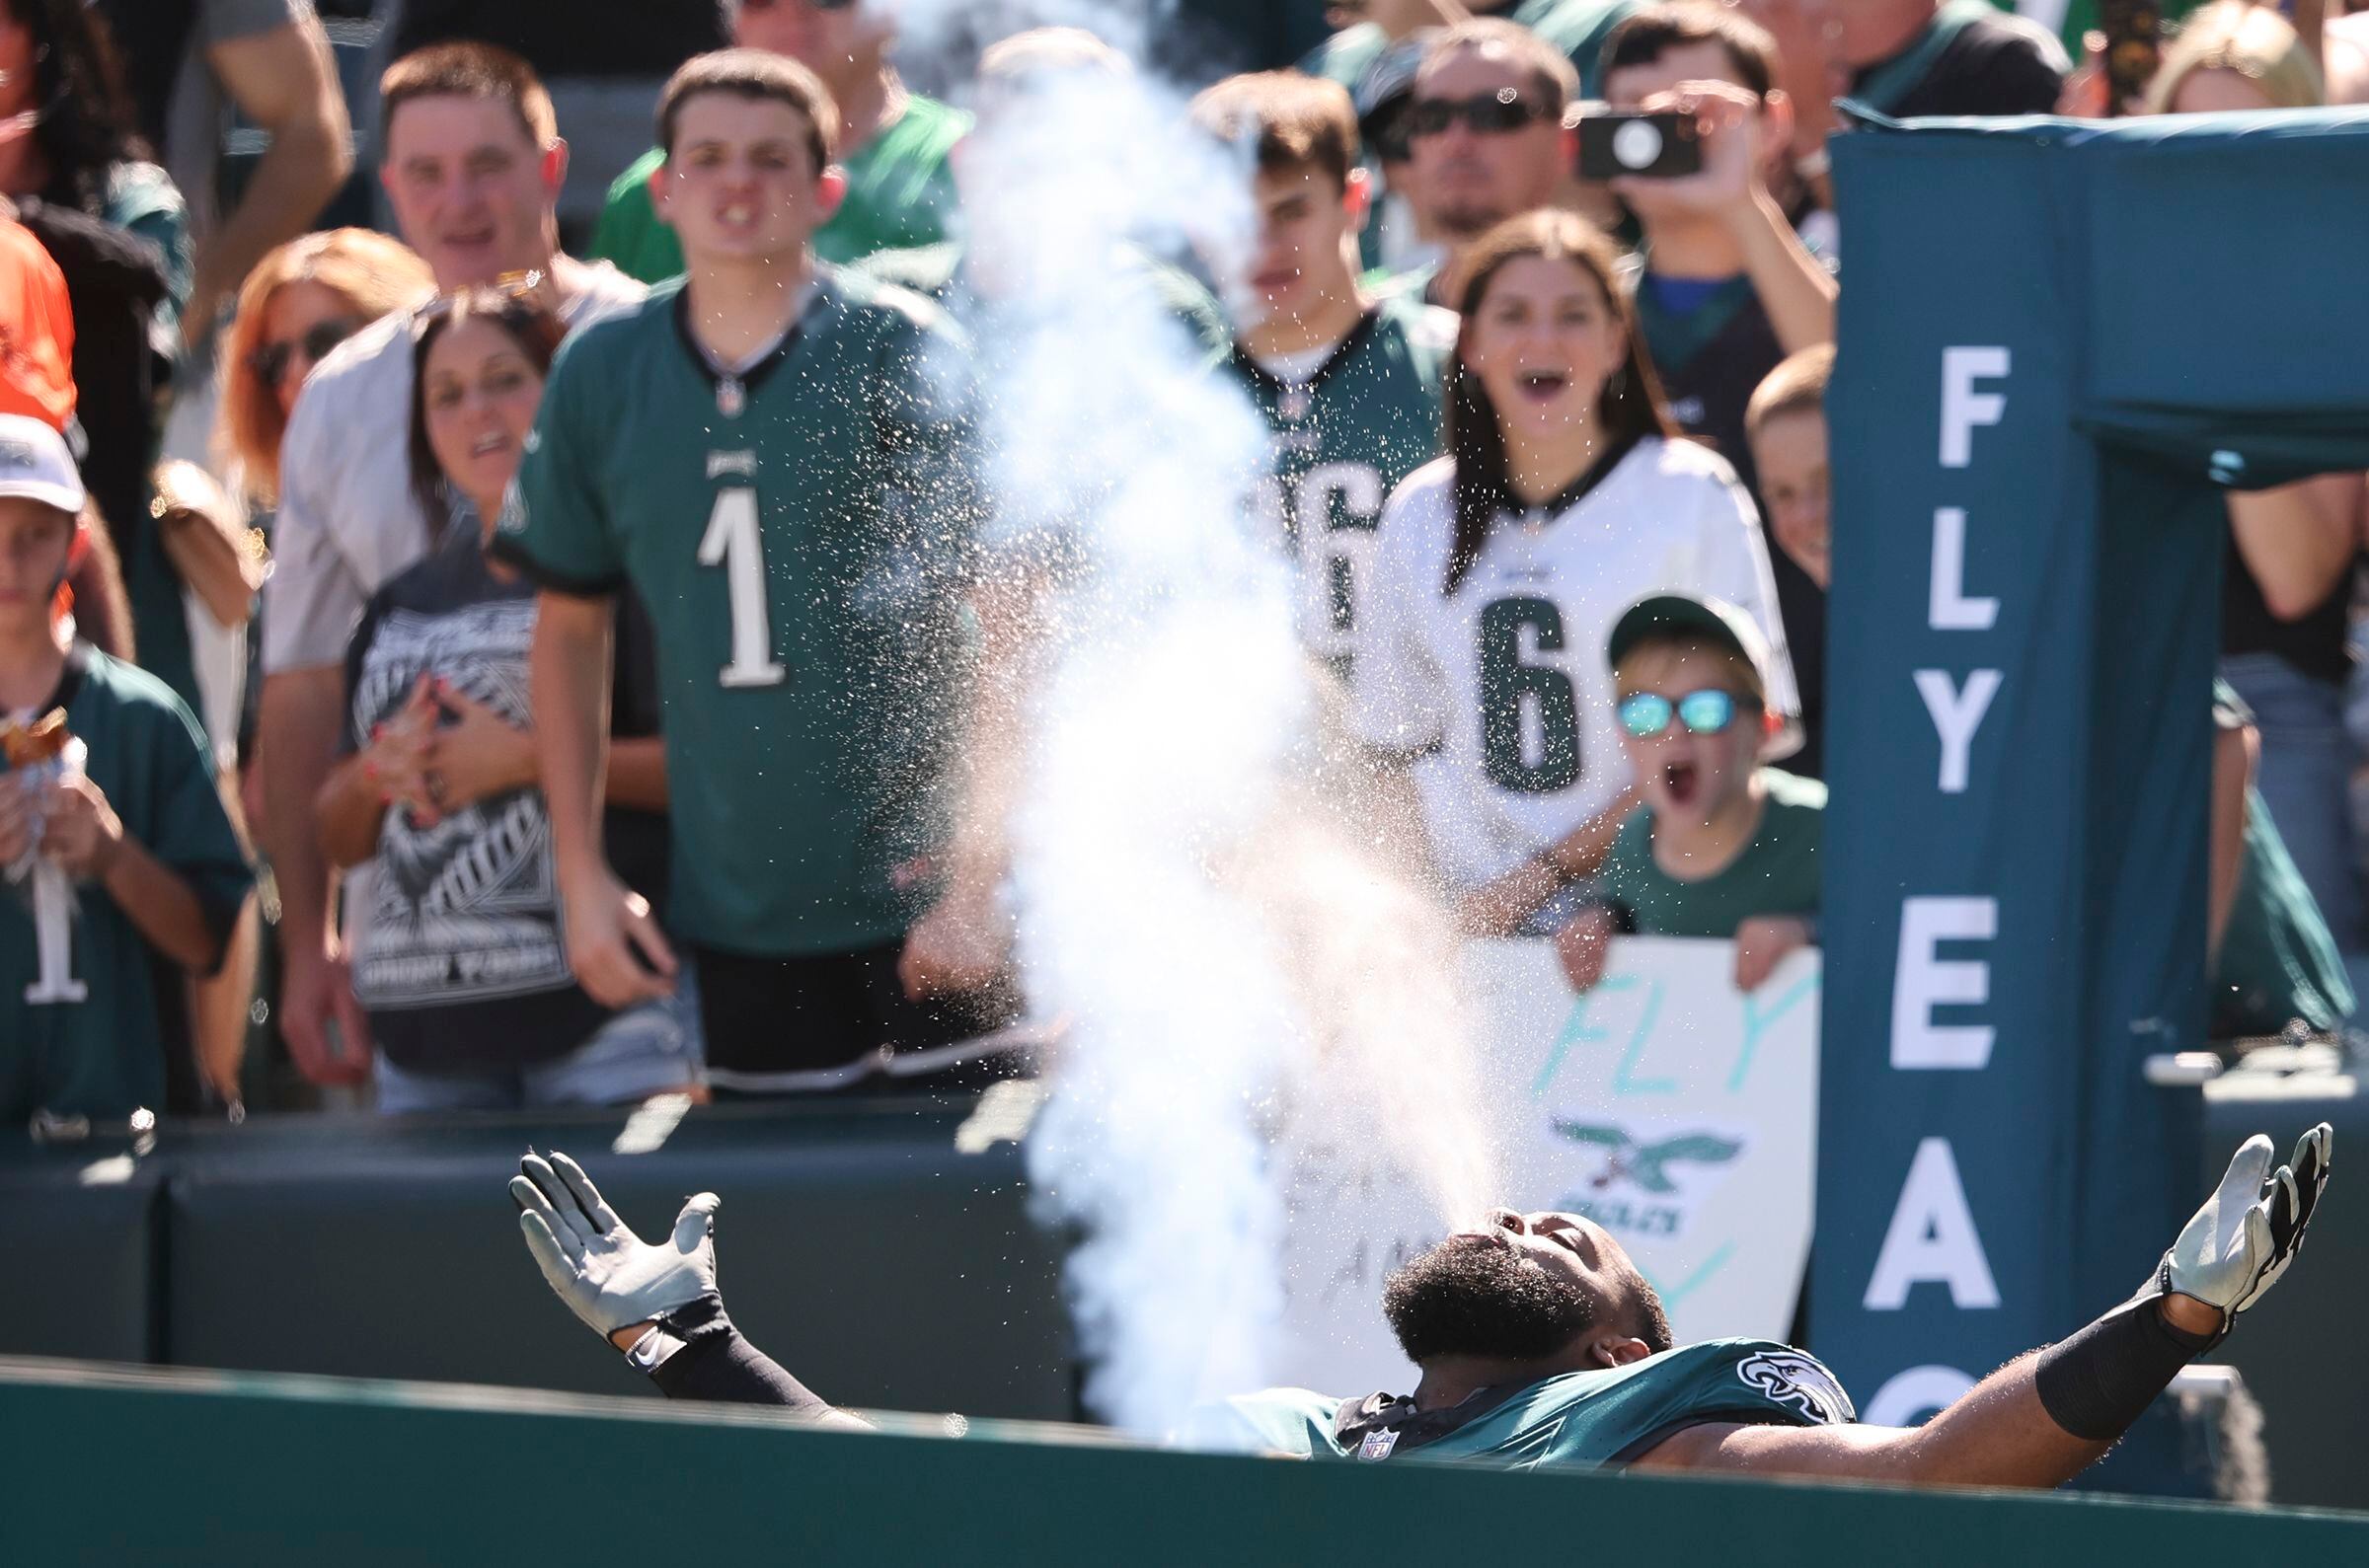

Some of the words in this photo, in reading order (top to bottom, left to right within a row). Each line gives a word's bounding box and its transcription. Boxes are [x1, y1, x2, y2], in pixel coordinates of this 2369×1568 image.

[697, 486, 787, 688] 1
[1912, 345, 2012, 793] FLY
[1480, 597, 1581, 792] 6
[1533, 972, 1822, 1098] FLY
[1364, 1443, 1387, 1457] NFL
